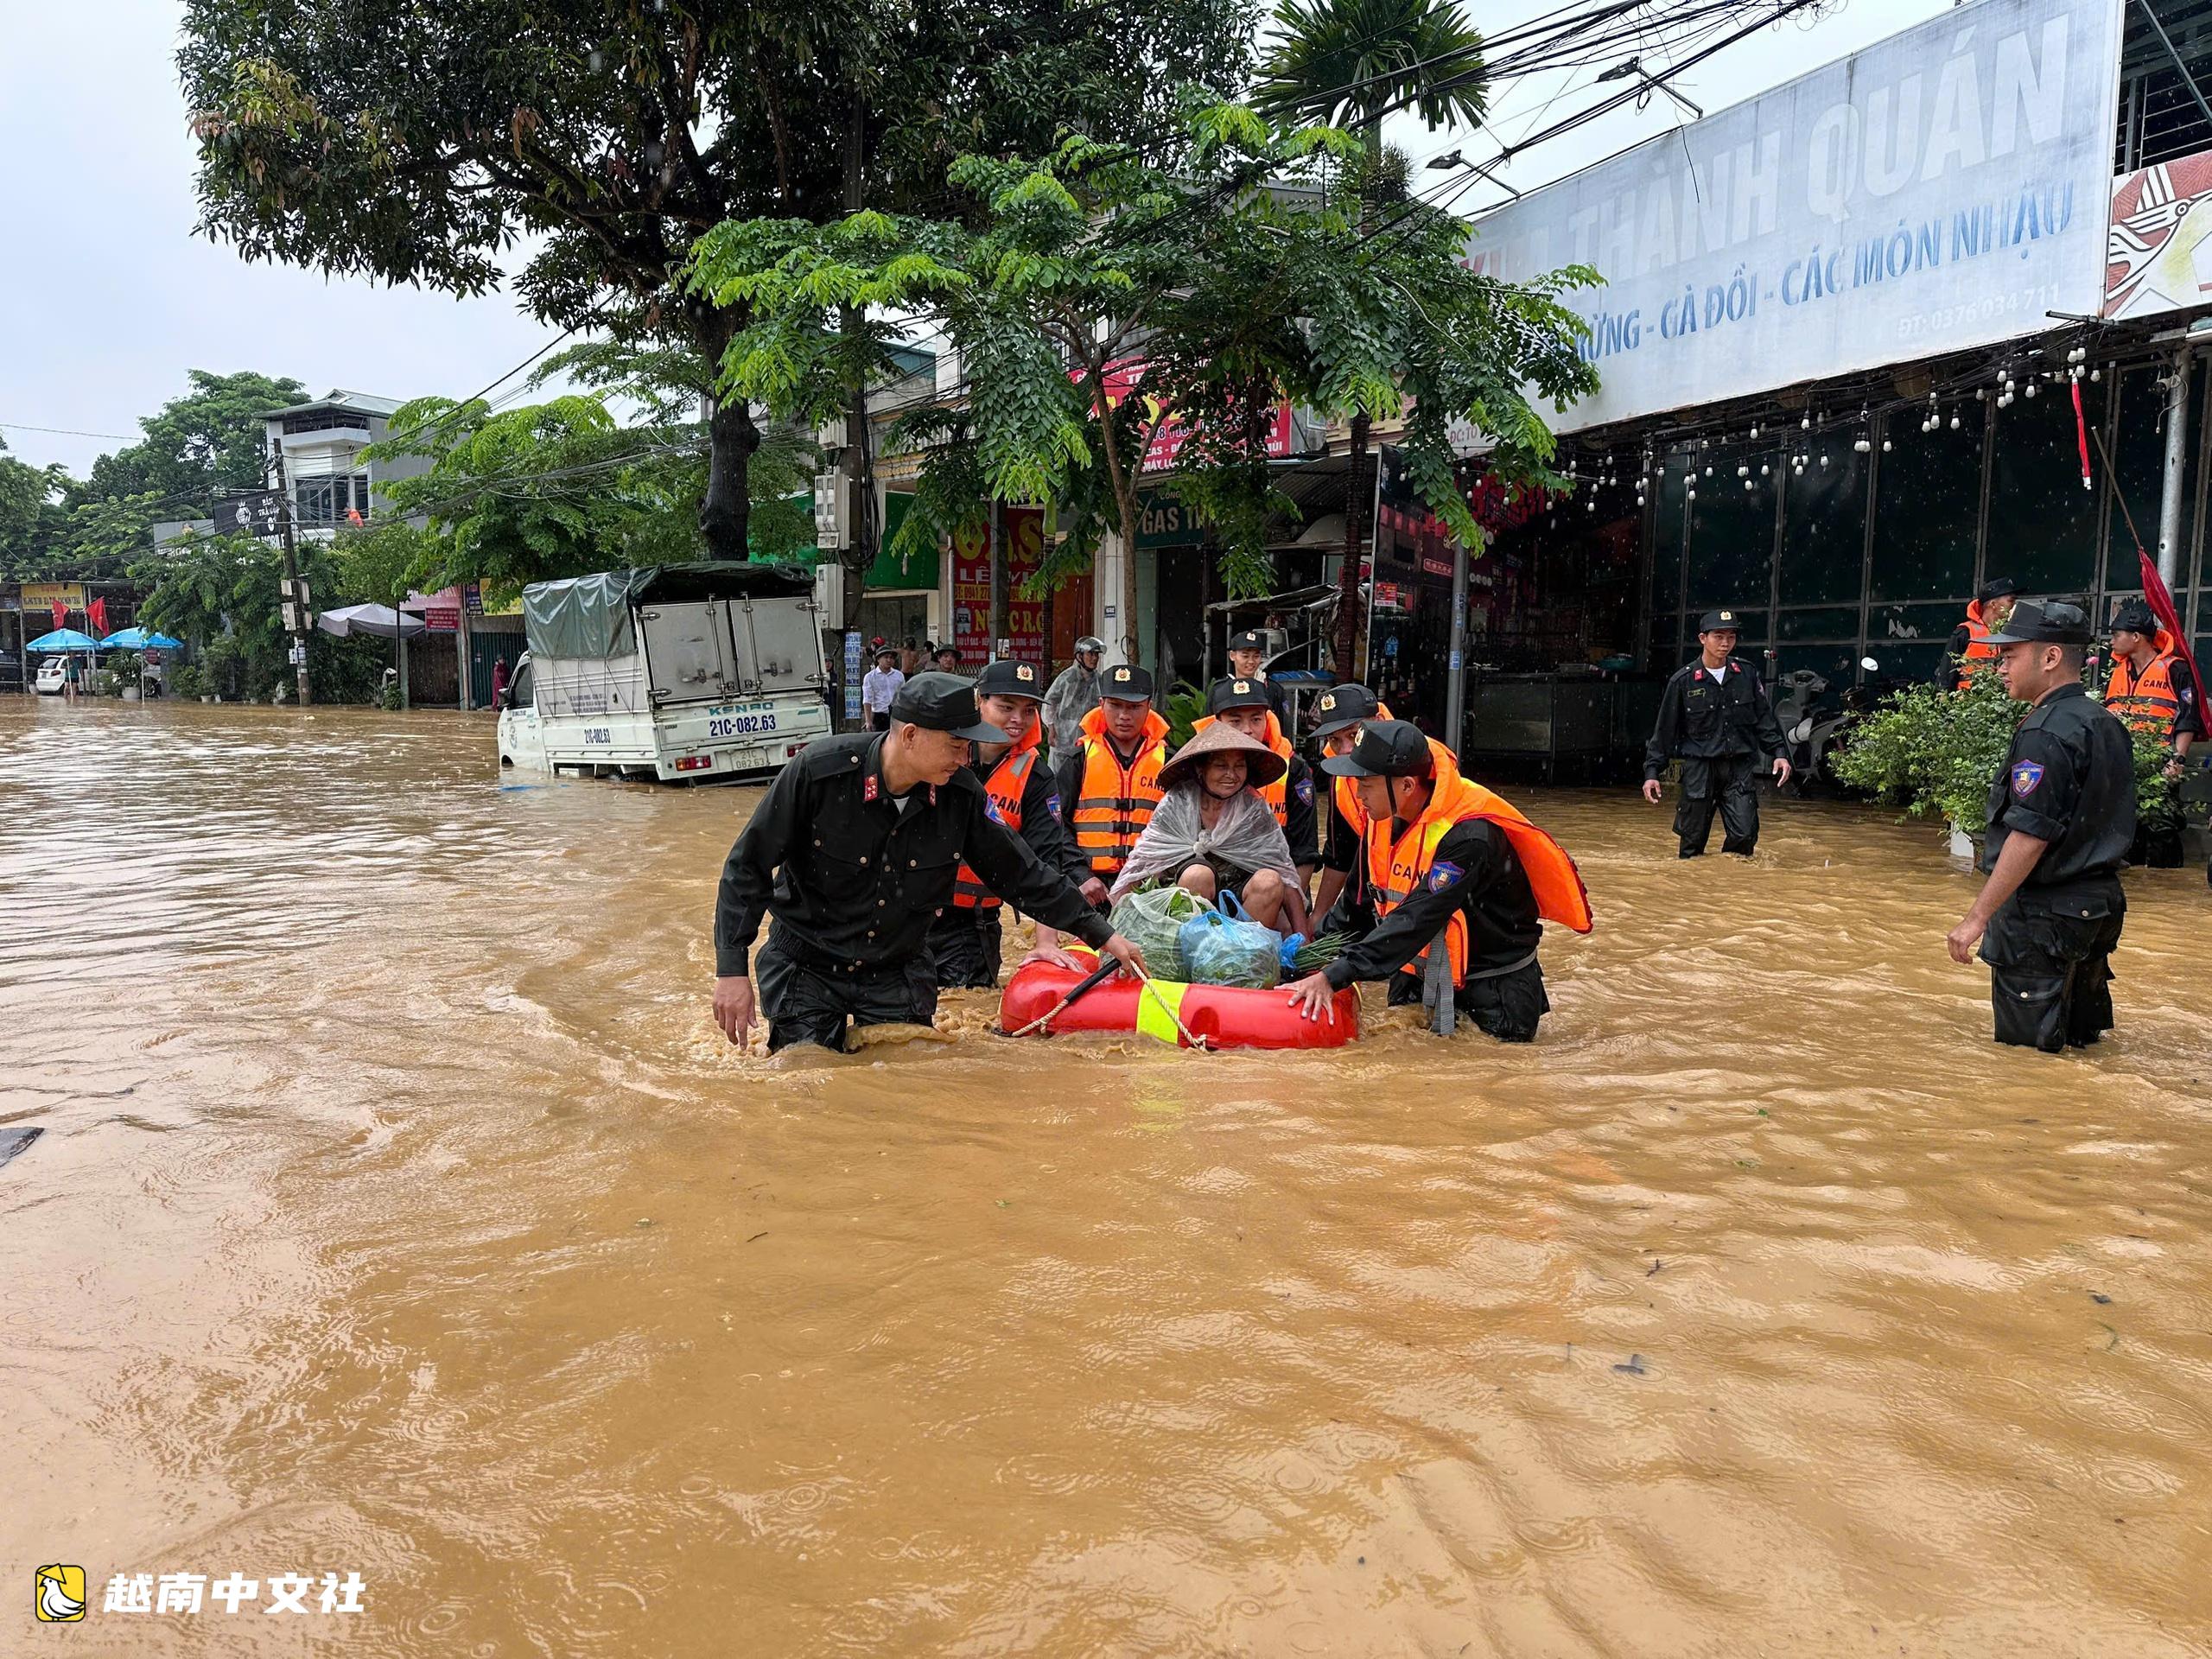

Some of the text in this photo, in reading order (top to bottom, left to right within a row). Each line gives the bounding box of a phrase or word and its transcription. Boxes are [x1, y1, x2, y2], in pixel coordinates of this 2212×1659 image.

[1807, 13, 2069, 225] QUÁN
[1660, 283, 1697, 340] GÀ
[1704, 262, 1758, 330] ĐỒI
[1781, 243, 1844, 306] CÁC
[1853, 219, 1942, 289] MÓN
[2023, 282, 2061, 310] 711
[1141, 506, 1180, 536] GAS
[584, 728, 611, 745] 21C-082.63
[709, 715, 776, 737] 21C-082.63
[735, 758, 766, 770] 082.63
[741, 750, 757, 760] 21C
